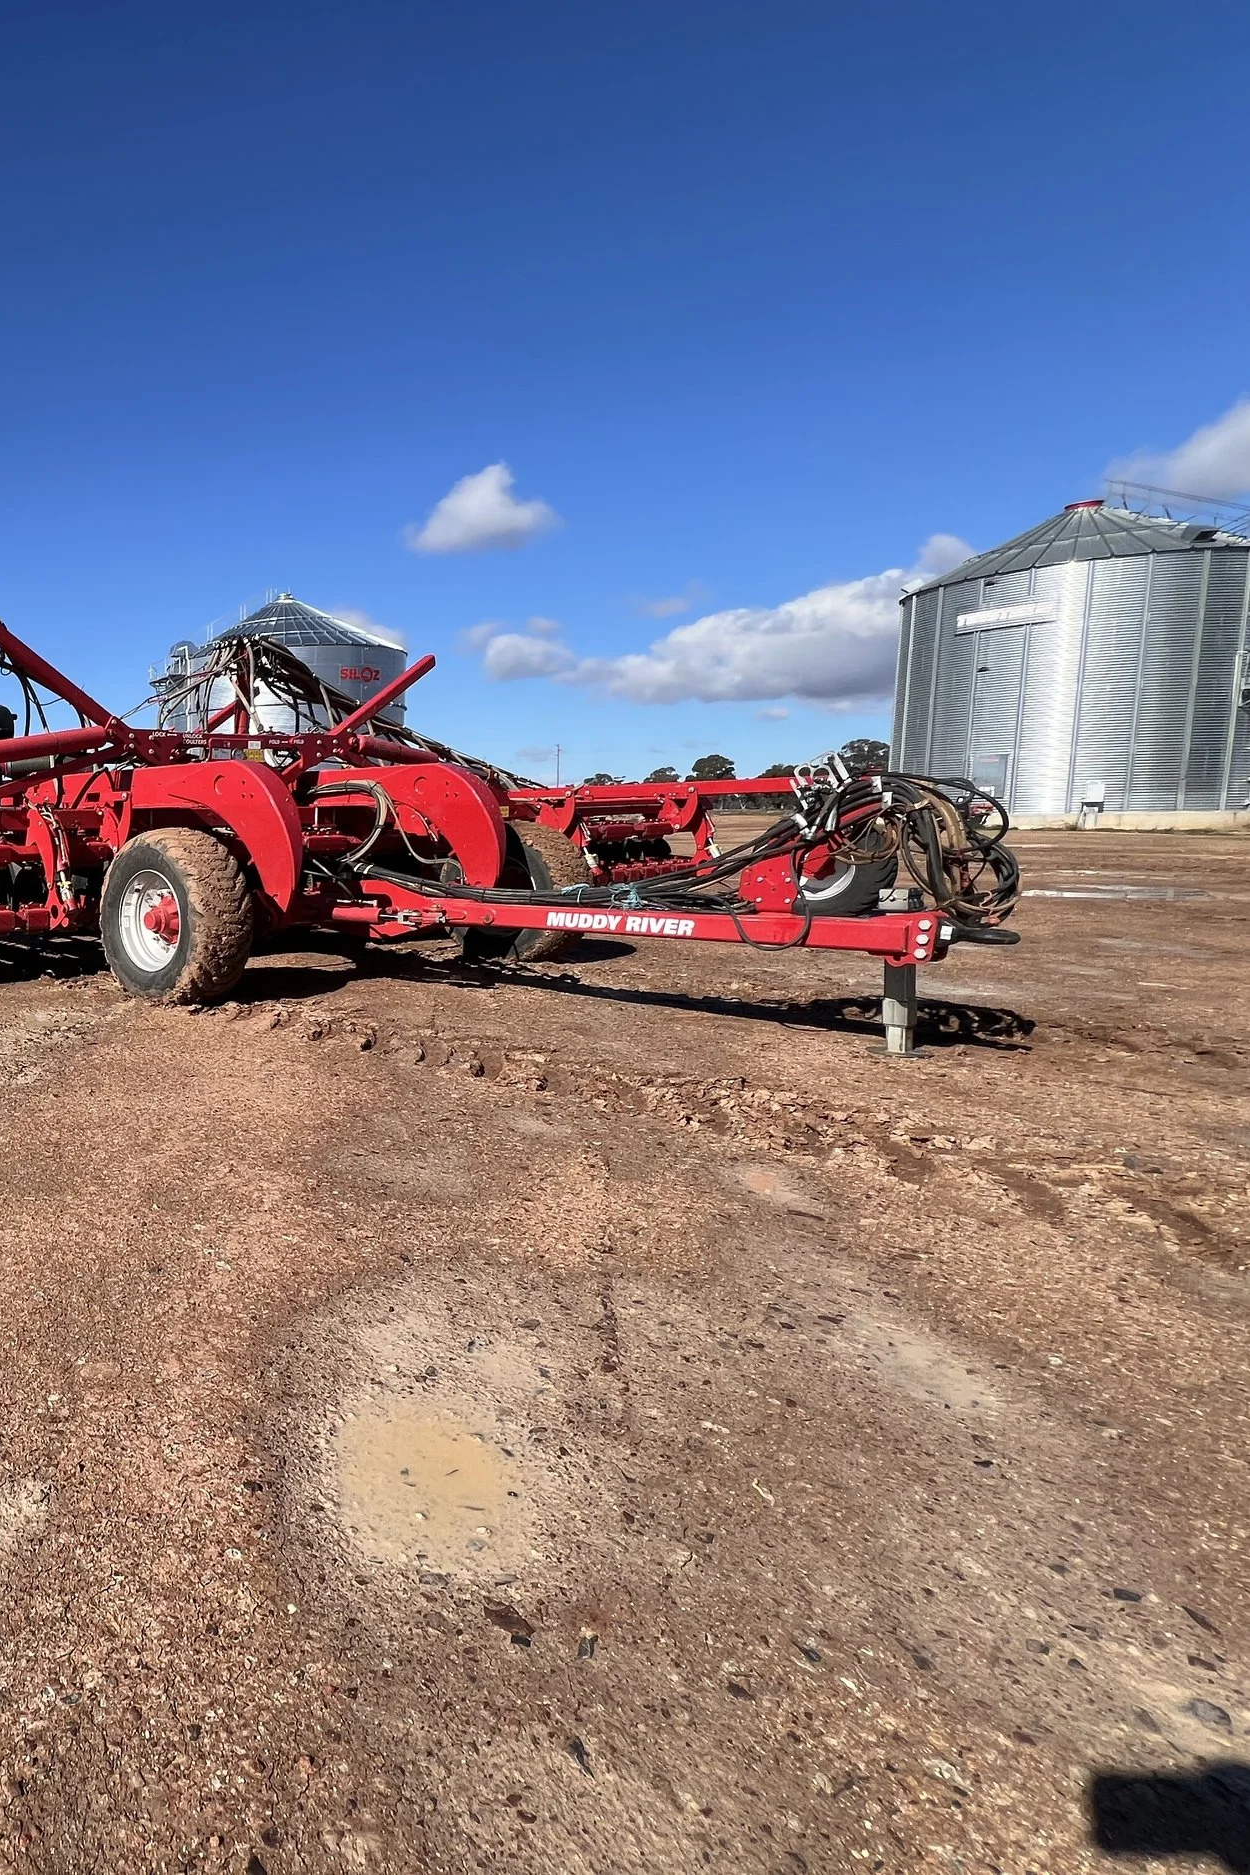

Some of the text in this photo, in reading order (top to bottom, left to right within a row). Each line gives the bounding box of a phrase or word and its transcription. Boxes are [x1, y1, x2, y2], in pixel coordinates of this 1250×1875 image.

[340, 666, 380, 682] SILOZ
[547, 912, 695, 936] MUDDY RIVER
